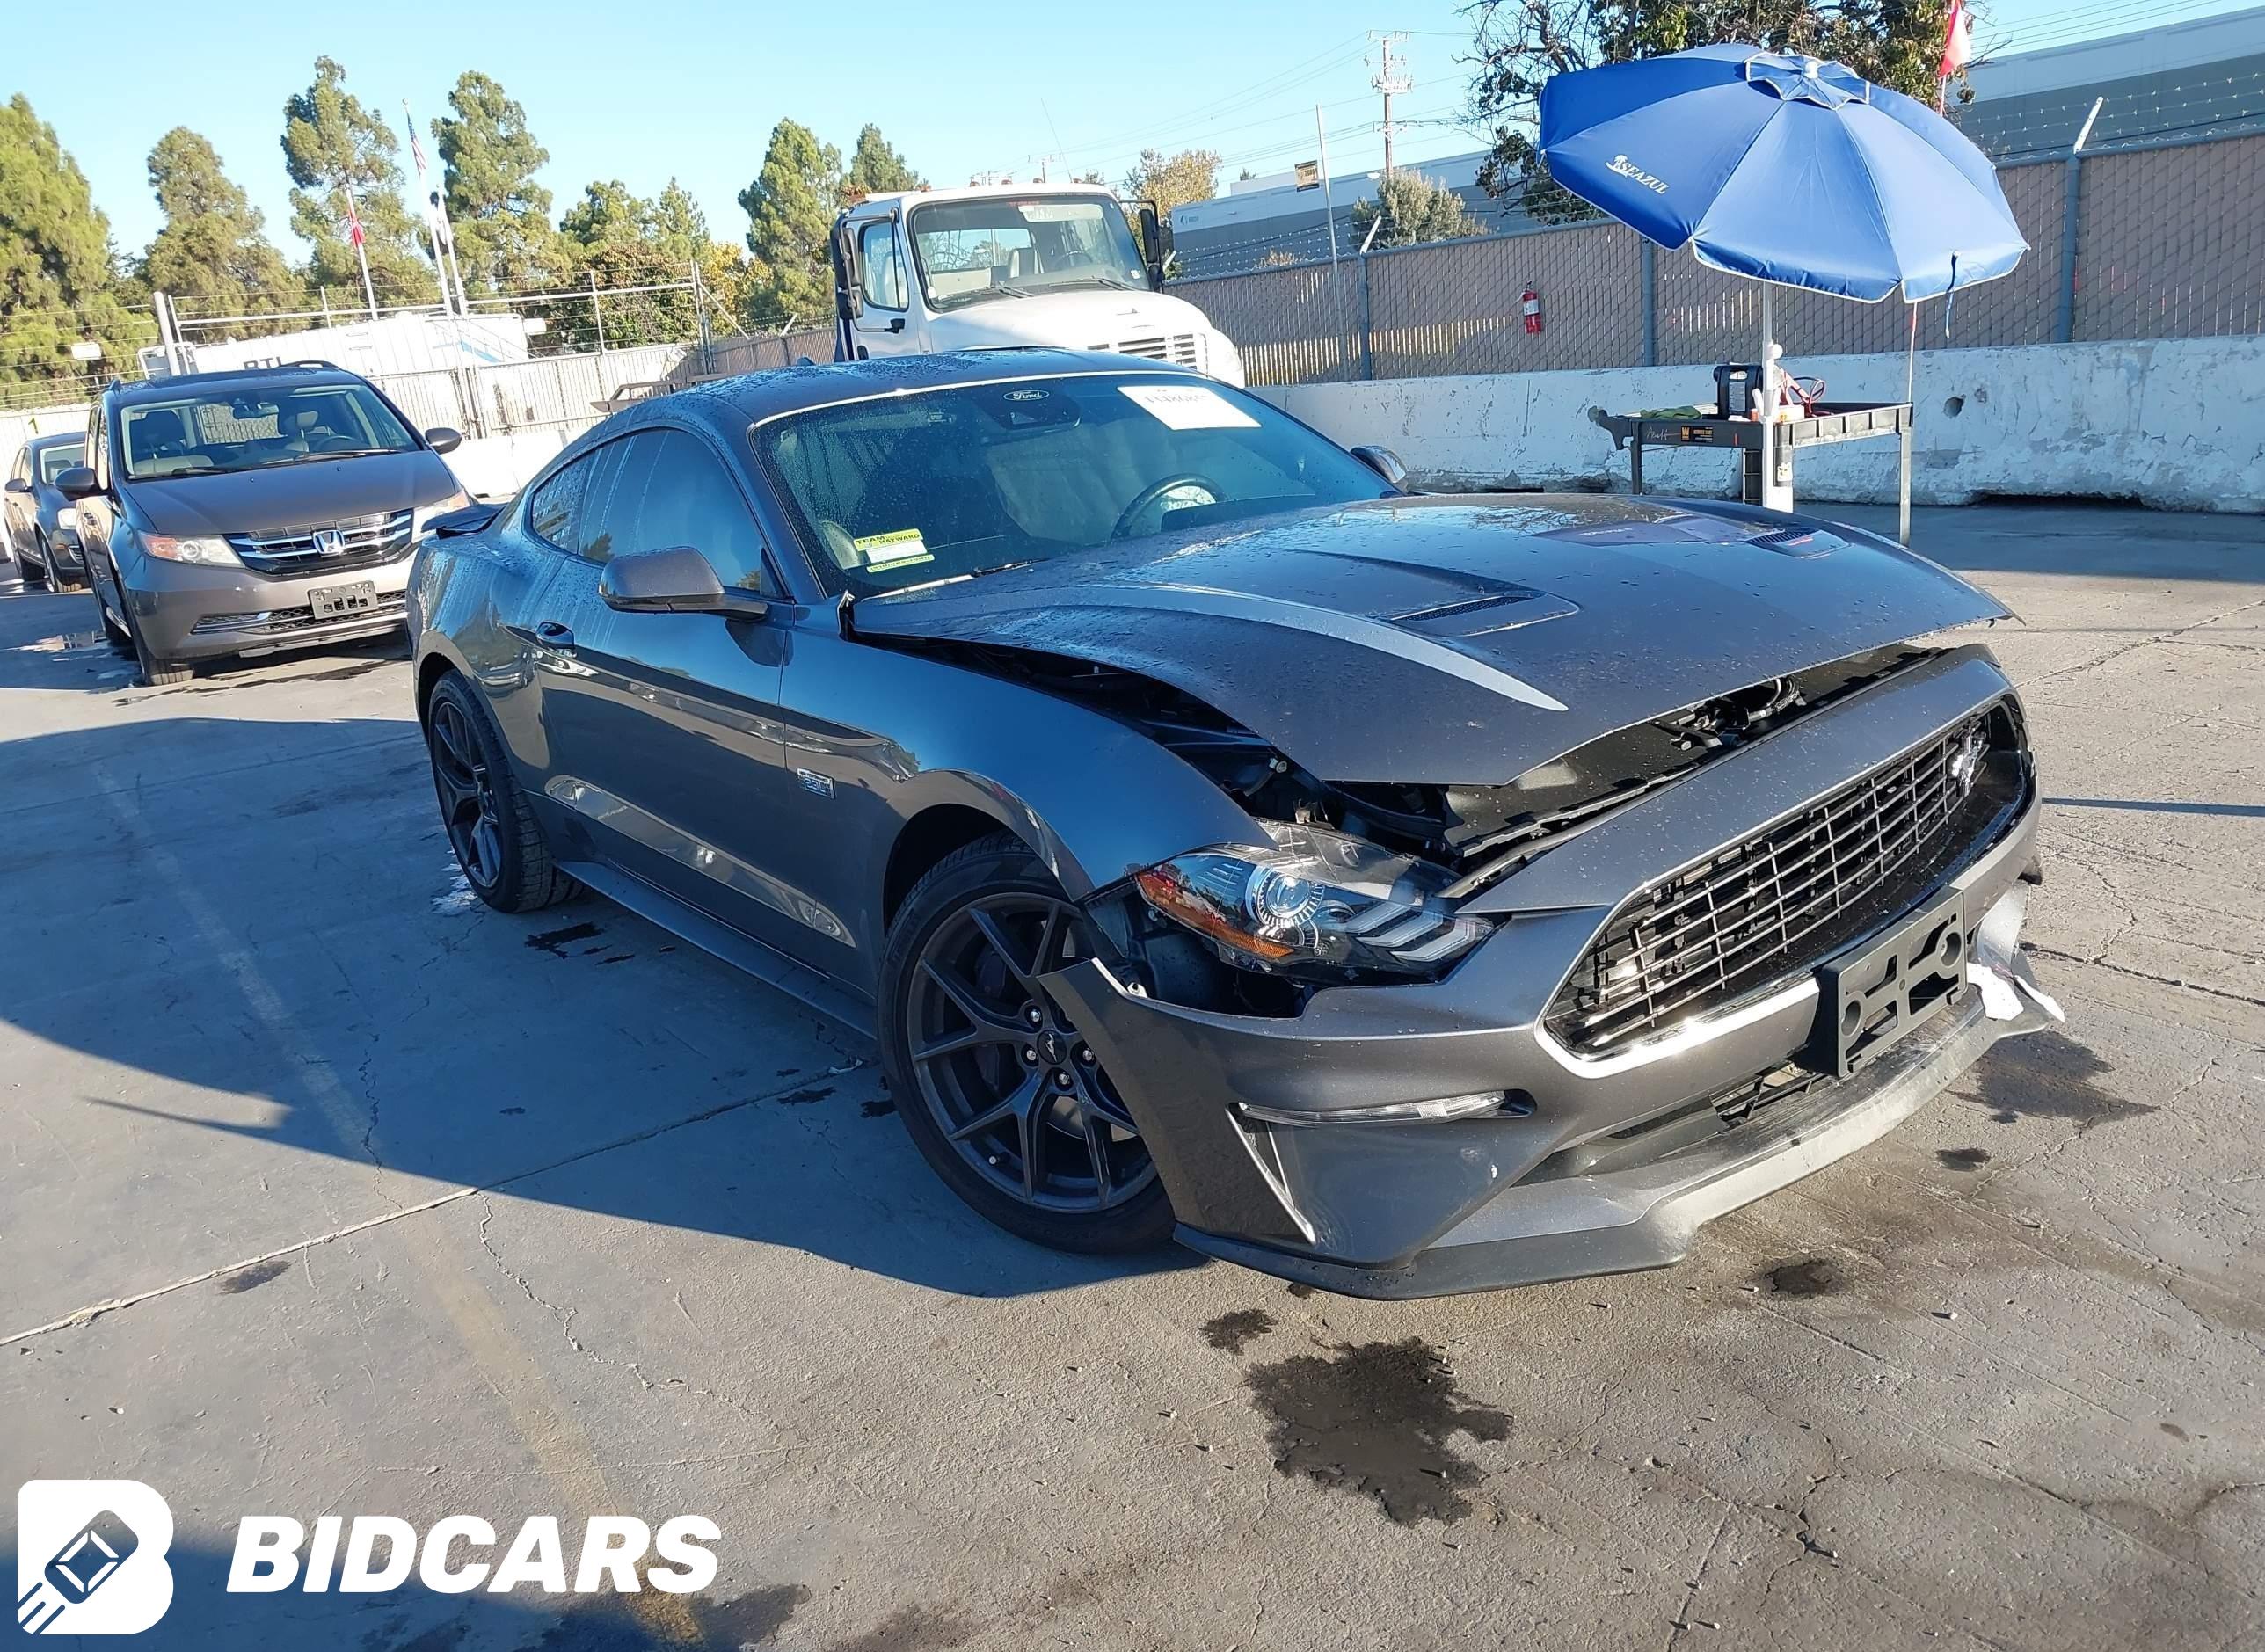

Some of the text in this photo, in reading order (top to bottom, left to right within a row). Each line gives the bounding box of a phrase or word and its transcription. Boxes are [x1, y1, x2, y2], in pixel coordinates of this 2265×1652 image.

[1621, 162, 1670, 194] SEAZUL
[856, 535, 885, 545] TEAM
[879, 534, 920, 544] HAYWARD
